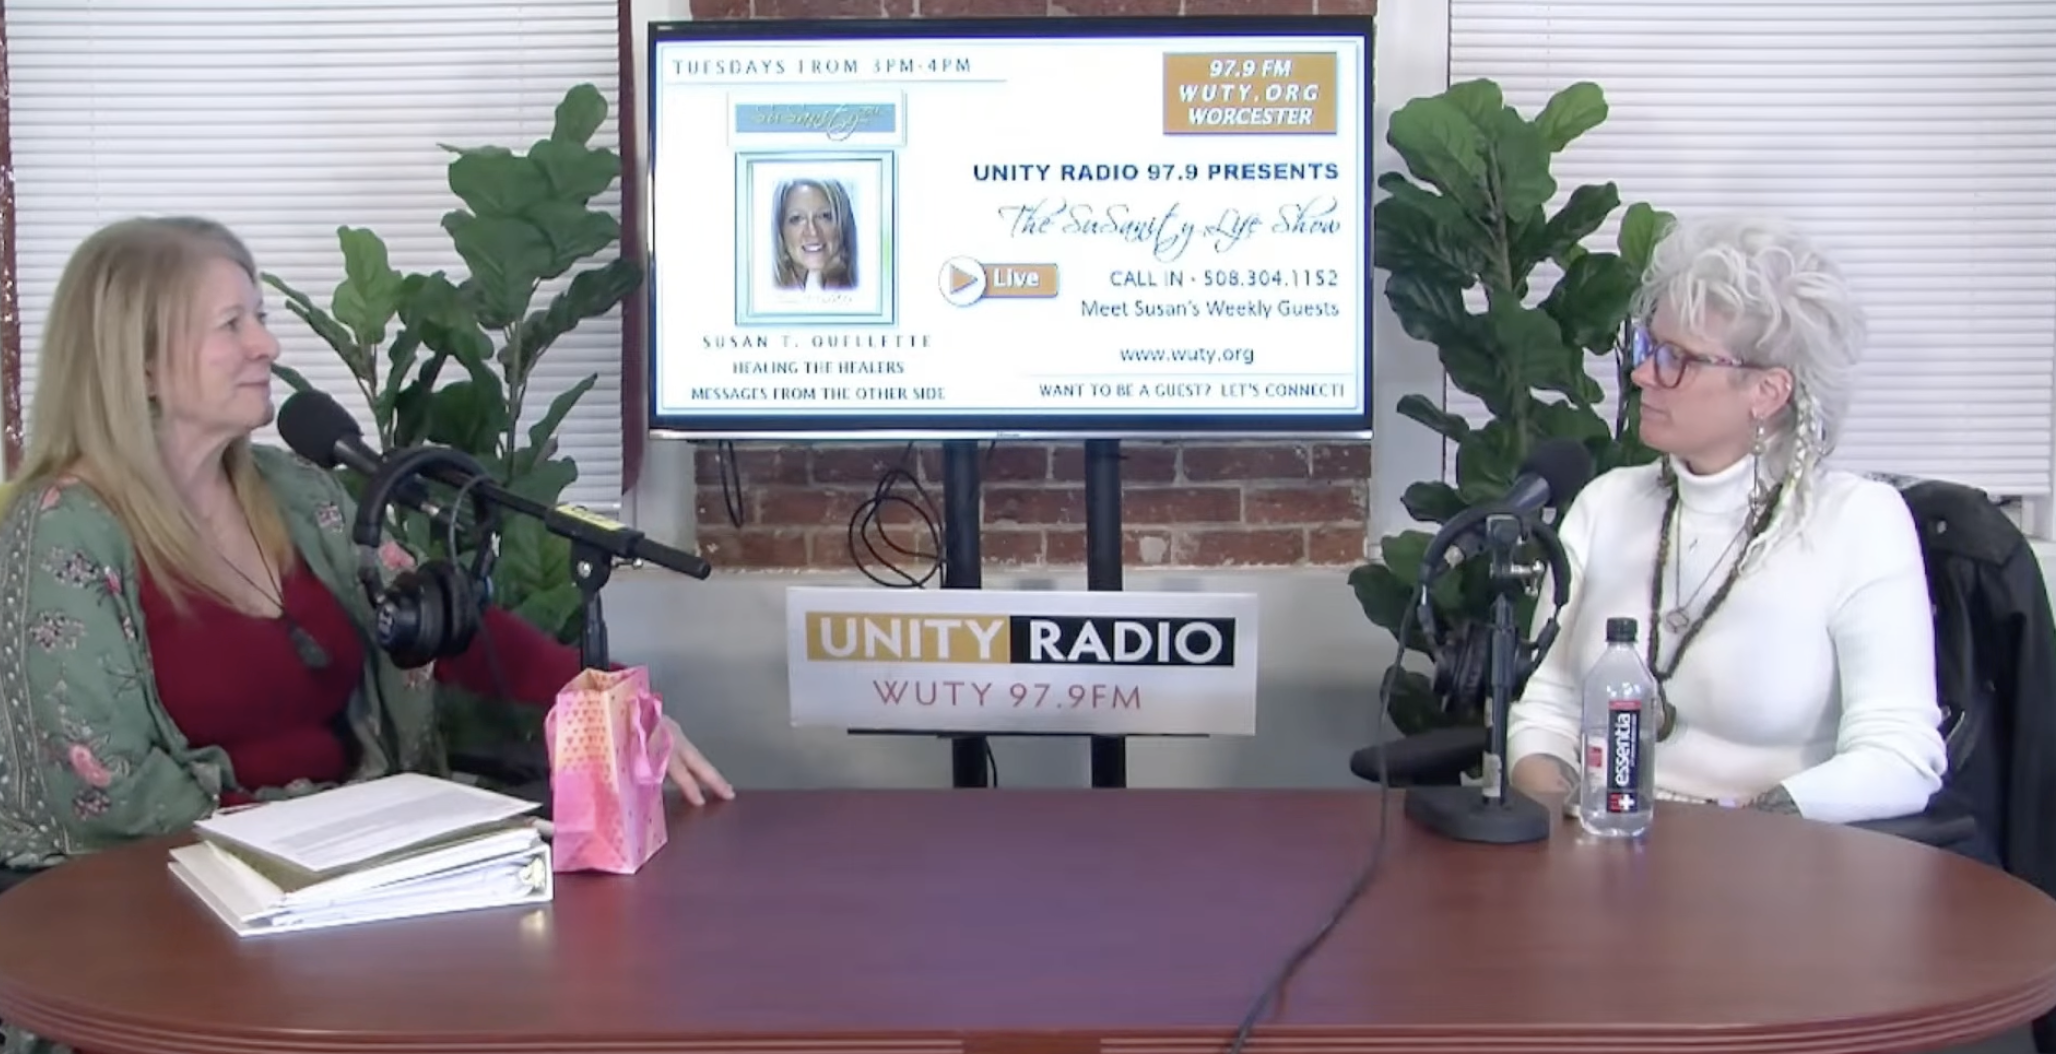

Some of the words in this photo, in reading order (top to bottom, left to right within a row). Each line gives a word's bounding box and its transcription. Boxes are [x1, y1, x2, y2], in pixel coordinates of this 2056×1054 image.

[673, 60, 786, 75] TUESDAYS
[798, 59, 858, 74] FROM
[1209, 59, 1255, 78] 97.9
[1261, 59, 1292, 78] FM
[1178, 83, 1319, 102] WUTY.ORG
[1188, 107, 1313, 125] WORCESTER
[973, 164, 1051, 182] UNITY
[1061, 164, 1139, 182] RADIO
[1147, 164, 1198, 181] 97.9
[1208, 162, 1339, 181] PRESENTS
[997, 198, 1067, 238] The
[1271, 196, 1341, 235] Show
[993, 267, 1040, 287] Live
[1110, 270, 1157, 287] CALL
[1164, 270, 1184, 287] IN
[1204, 269, 1338, 287] 508.304.1152
[1081, 300, 1129, 317] Meet
[1134, 299, 1200, 317] Susan's
[1206, 299, 1272, 319] Weekly
[1277, 299, 1340, 317] Guests
[702, 334, 768, 348] SUSAN
[1119, 348, 1254, 365] www.wuty.org
[732, 361, 799, 374] HEALING
[804, 361, 833, 374] THE
[838, 360, 904, 374] HEALERS
[691, 387, 768, 400] MESSAGES
[772, 387, 816, 400] FROM
[821, 387, 851, 400] THE
[855, 386, 908, 401] OTHER
[912, 387, 946, 400] SIDE
[1039, 384, 1083, 397] WANT
[1090, 384, 1112, 397] TO
[1116, 384, 1134, 397] BE
[1139, 384, 1150, 397] A
[1155, 383, 1212, 397] GUEST?
[1220, 383, 1259, 397] LET'S
[819, 616, 1005, 660] UNITY
[1029, 619, 1223, 664] RADIO
[872, 680, 993, 707] WUTY
[1009, 682, 1142, 709] 97.9FM
[1615, 712, 1631, 787] essentia
